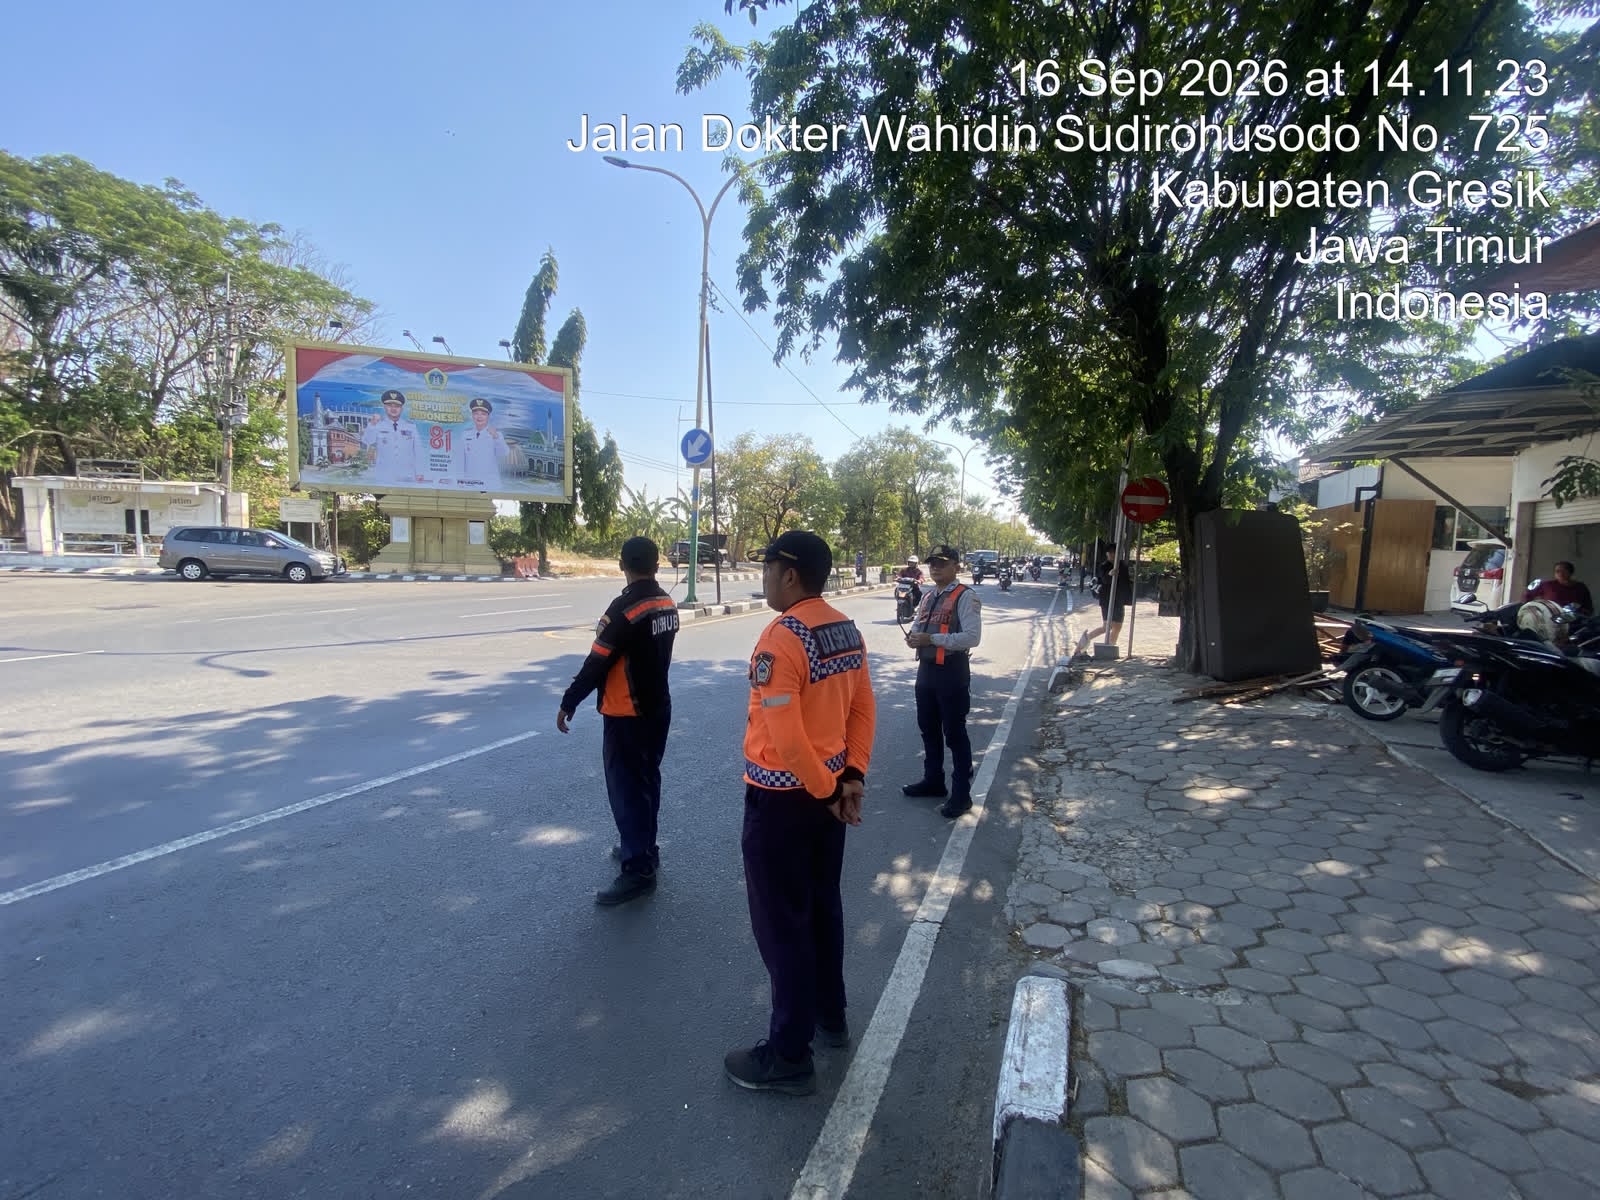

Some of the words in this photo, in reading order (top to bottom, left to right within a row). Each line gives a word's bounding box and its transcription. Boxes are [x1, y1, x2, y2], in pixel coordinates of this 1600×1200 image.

[409, 411, 464, 423] INDONESIA
[429, 425, 452, 452] 81
[88, 494, 112, 503] jatim
[169, 496, 192, 504] jatim
[651, 613, 679, 636] DISHUB
